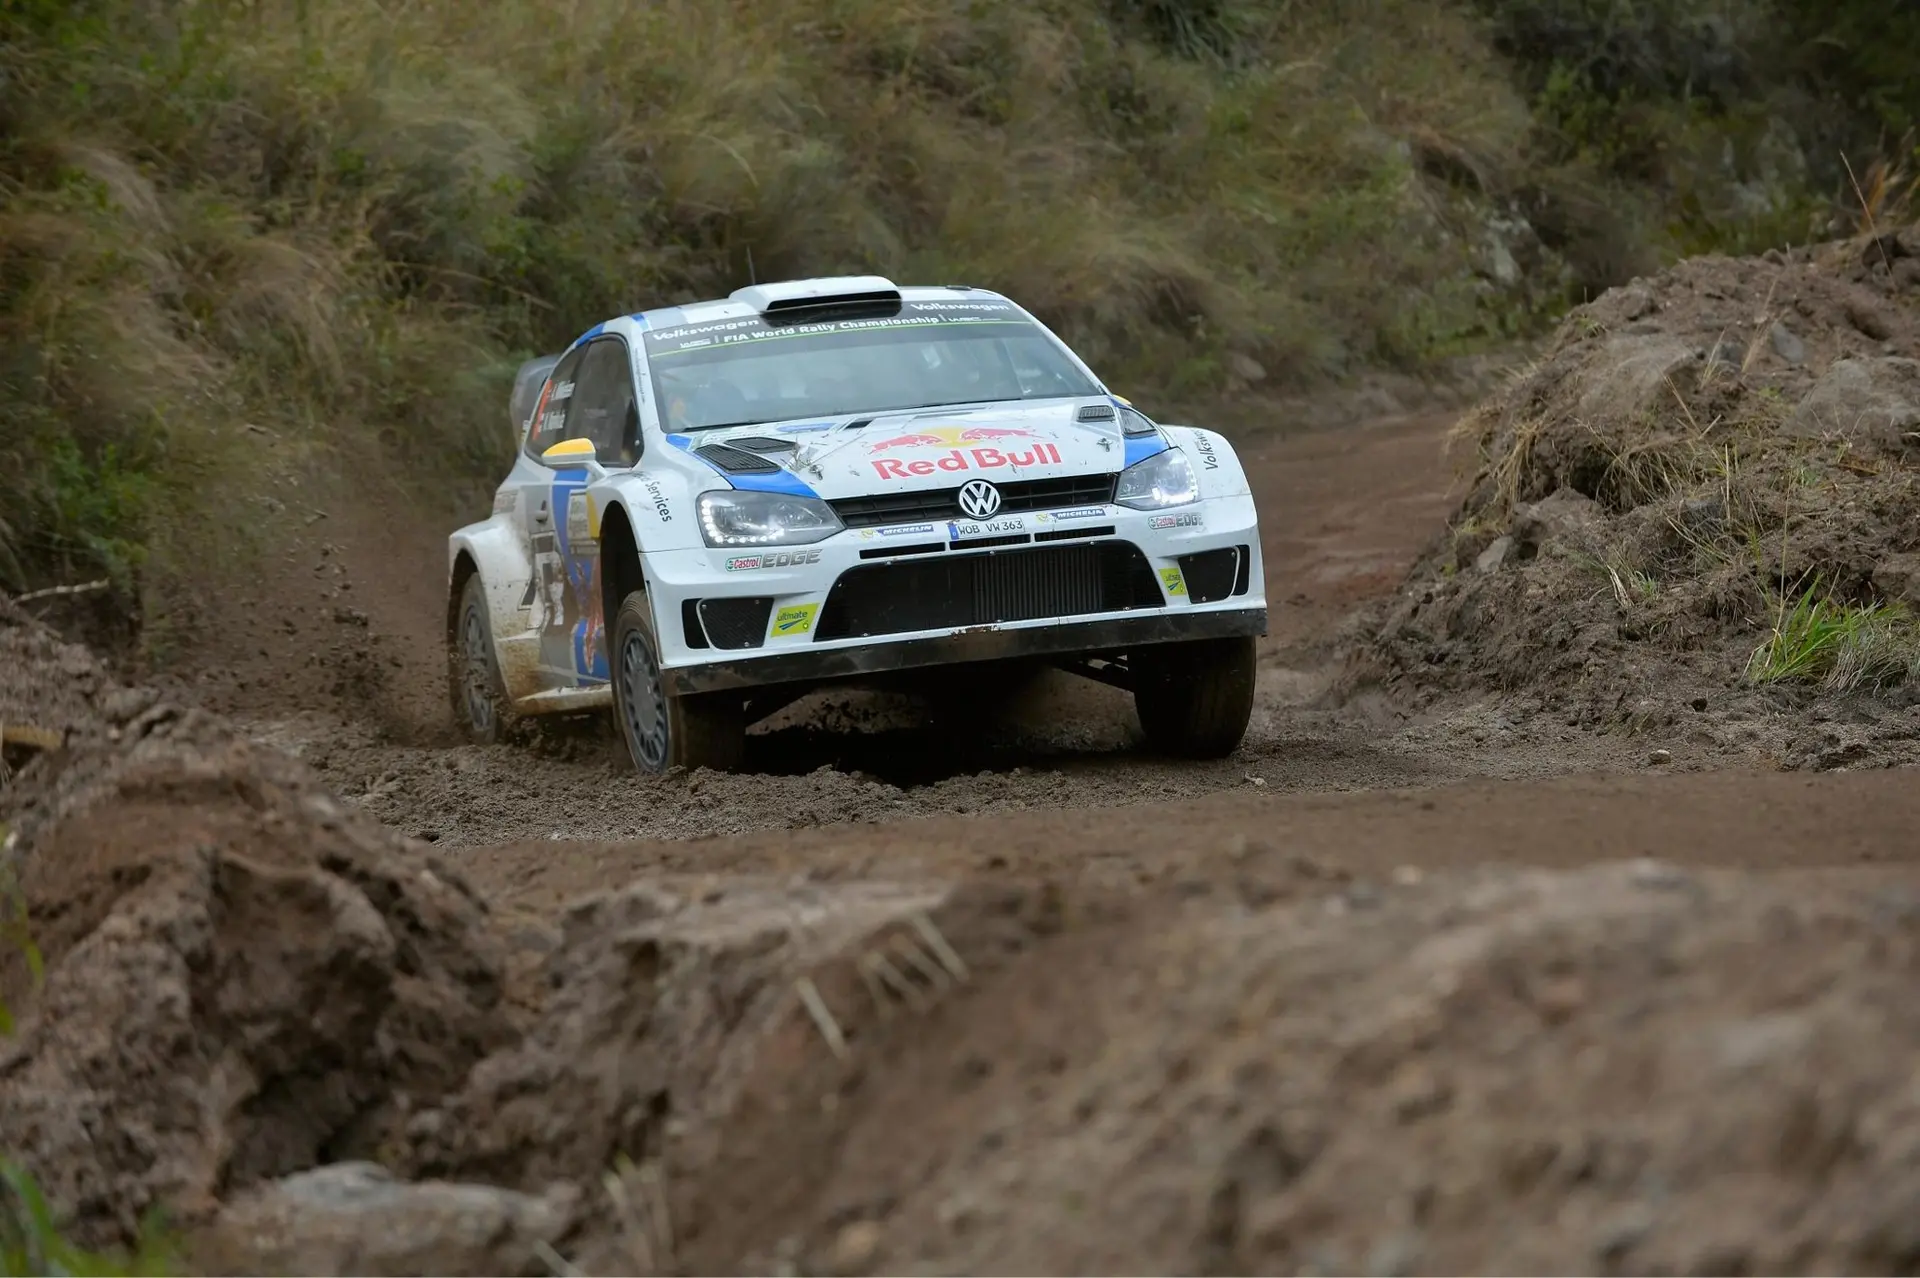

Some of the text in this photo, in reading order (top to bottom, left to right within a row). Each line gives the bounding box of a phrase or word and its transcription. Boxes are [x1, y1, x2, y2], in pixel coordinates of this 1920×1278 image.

[910, 302, 1010, 312] Volkswagen
[653, 319, 759, 341] Volkswagen
[723, 333, 749, 343] FIA
[751, 327, 795, 339] World
[800, 324, 835, 334] Rally
[840, 316, 939, 330] Championship
[871, 443, 1062, 480] Red Bull
[645, 481, 672, 522] Services
[1057, 509, 1103, 518] MICHELIN
[883, 525, 932, 535] MICHELIN
[958, 520, 1022, 535] WOB VW 363
[733, 549, 822, 569] Castrol EDGE
[777, 610, 808, 621] ultimate
